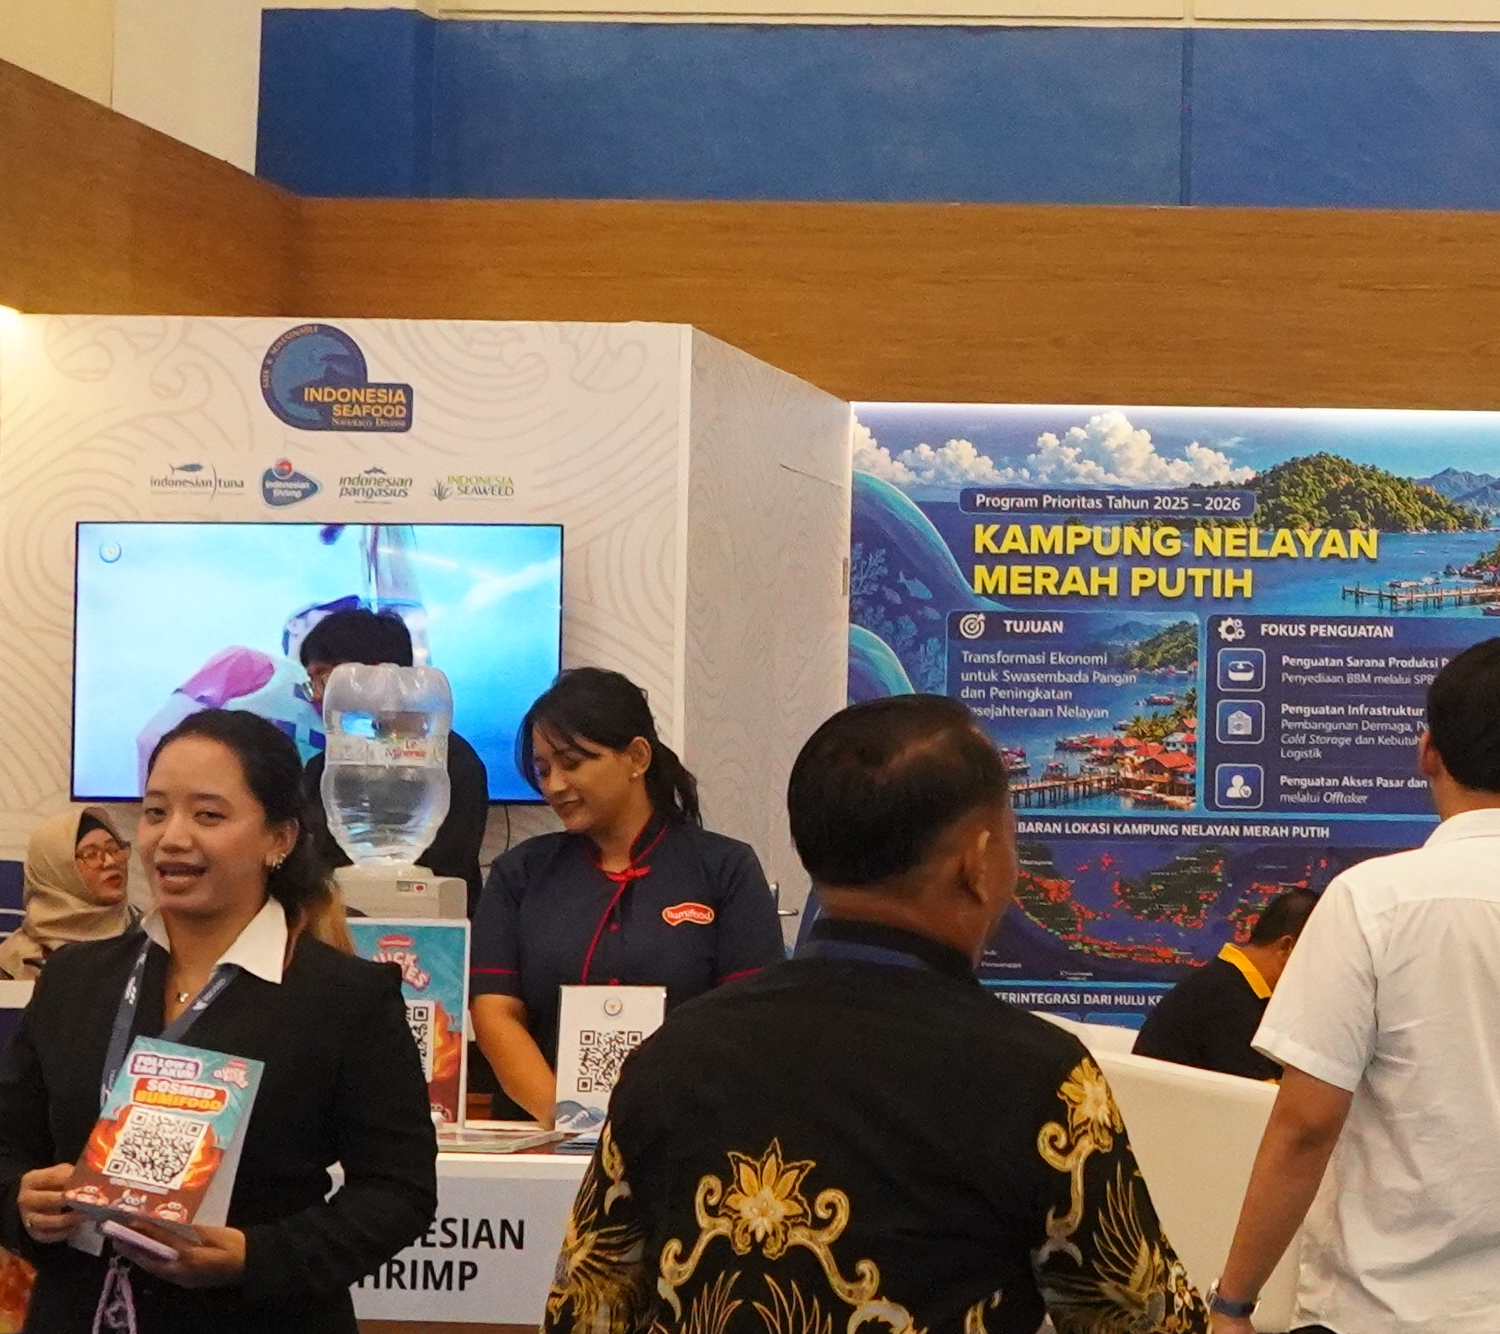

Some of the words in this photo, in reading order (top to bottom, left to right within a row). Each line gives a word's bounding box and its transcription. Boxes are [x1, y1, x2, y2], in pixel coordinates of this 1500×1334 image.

[304, 387, 407, 404] INDONESIA
[332, 404, 407, 418] SEAFOOD
[150, 474, 213, 488] indonesian
[217, 477, 245, 489] tuna
[339, 474, 414, 488] indonesian
[447, 475, 514, 486] INDONESIA
[976, 494, 1039, 514] Program
[1042, 494, 1103, 510] Prioritas
[1106, 495, 1149, 510] Tahun
[1153, 496, 1189, 510] 2025
[1204, 497, 1241, 511] 2026
[974, 524, 1182, 557] KAMPUNG
[1194, 528, 1378, 560] NELAYAN
[974, 565, 1119, 596] MERAH
[1131, 568, 1253, 598] PUTIH
[1003, 619, 1064, 634] TUJUAN
[1261, 623, 1307, 637] FOKUS
[1310, 624, 1394, 638] PENGUATAN
[962, 651, 1047, 666] Transformasi
[1049, 652, 1108, 666] Ekonomi
[1282, 655, 1343, 668] Penguatan
[1346, 656, 1385, 668] Sarana
[1388, 656, 1439, 669] Produksi
[960, 669, 999, 683] untuk
[1002, 670, 1089, 684] Swasembada
[1092, 671, 1137, 687] Pangan
[1281, 673, 1344, 685] Penyediaan
[1347, 673, 1371, 684] BBM
[1374, 673, 1411, 685] melalui
[961, 686, 987, 700] dan
[990, 686, 1073, 704] Peningkatan
[969, 704, 1054, 721] esejahteraan
[1057, 705, 1109, 721] Nelayan
[1281, 704, 1345, 717] Penguatan
[1347, 704, 1425, 717] Infrastruktur
[1281, 720, 1359, 733] Pembangunan
[1281, 734, 1306, 745] Cold
[1308, 734, 1352, 748] Storage
[1355, 735, 1375, 746] dan
[1280, 747, 1322, 760] Logistik
[1280, 775, 1339, 788] Penguatan
[1342, 776, 1374, 788] Akses
[1376, 777, 1404, 788] Pasar
[1407, 777, 1428, 789] dan
[1279, 791, 1320, 803] melalui
[1014, 822, 1062, 834] BARAN
[1065, 823, 1111, 835] LOKASI
[1113, 823, 1179, 836] KAMPUNG
[1181, 824, 1240, 837] NELAYAN
[1243, 825, 1290, 837] MERAH
[1292, 826, 1330, 838] PUTIH
[1084, 994, 1112, 1006] DARI
[1115, 994, 1146, 1007] HULU
[146, 1079, 216, 1099] SOSMED
[134, 1090, 223, 1111] BUMIFOOD
[420, 1218, 525, 1249] ESIAN
